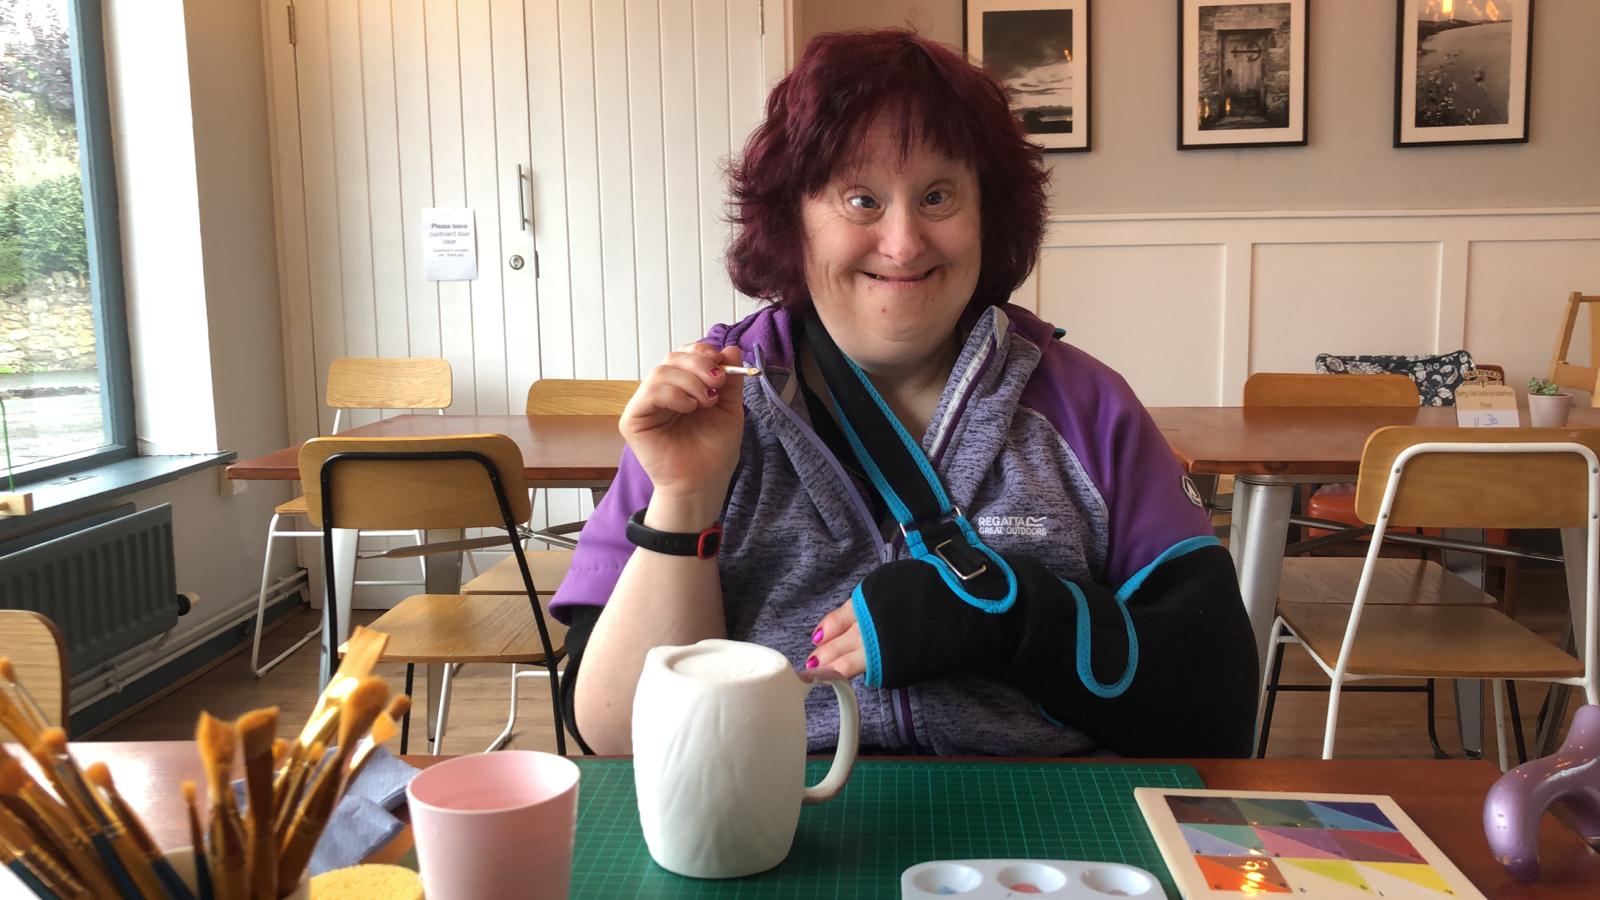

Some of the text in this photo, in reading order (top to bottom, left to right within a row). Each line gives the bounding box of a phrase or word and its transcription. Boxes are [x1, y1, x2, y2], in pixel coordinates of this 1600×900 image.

[978, 516, 1026, 527] REGATTA
[979, 526, 1047, 536] GREAT OUTDOORS
